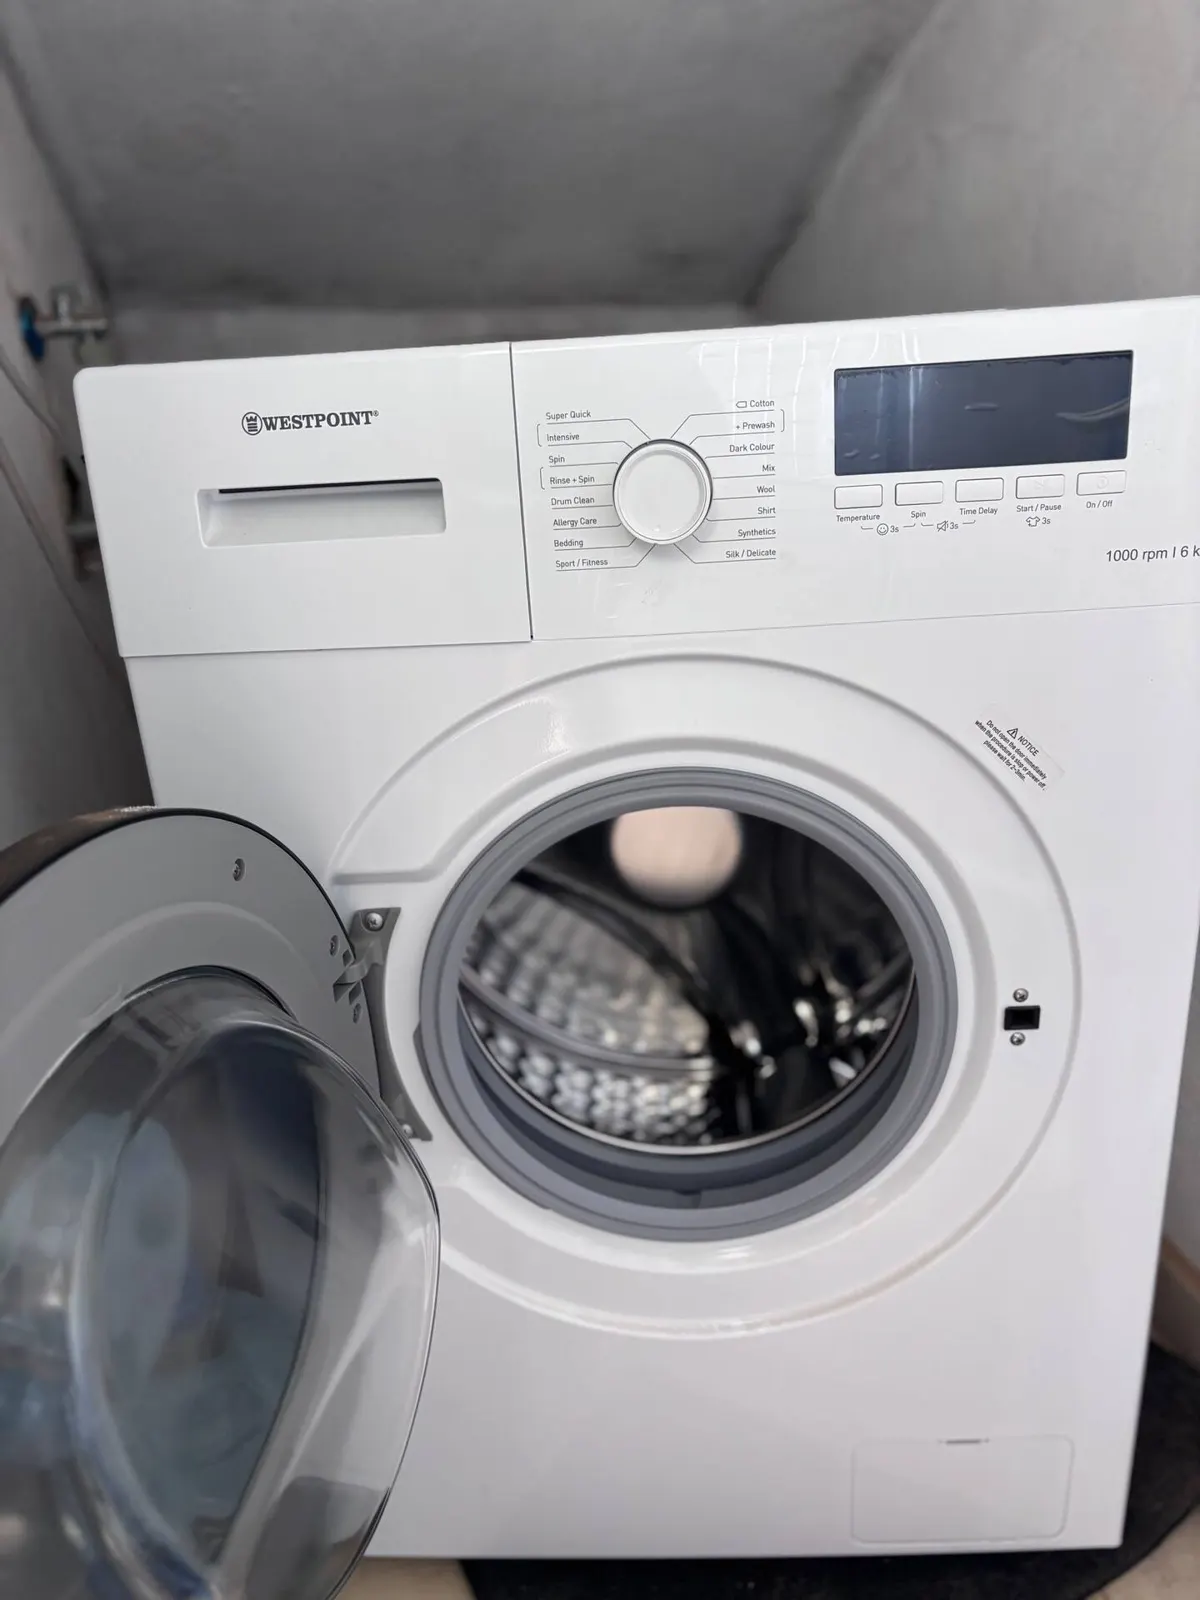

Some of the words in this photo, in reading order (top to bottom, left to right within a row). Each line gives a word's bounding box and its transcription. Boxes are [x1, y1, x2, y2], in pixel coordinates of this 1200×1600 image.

[749, 399, 775, 408] Cotton
[545, 412, 568, 420] Super
[570, 410, 591, 419] Quick
[742, 421, 775, 430] Prewash
[546, 433, 580, 441] Intensive
[729, 444, 747, 452] Dark
[748, 443, 775, 451] Colour
[548, 455, 565, 464] Spin
[762, 464, 776, 472] Mix
[549, 476, 570, 484] Rinse
[578, 475, 595, 483] Spin
[756, 485, 776, 494] Wool
[551, 498, 572, 506] Drum
[574, 496, 595, 504] Clean
[1102, 500, 1113, 508] Off
[757, 507, 776, 515] Shirt
[978, 506, 998, 516] Delay
[1016, 504, 1033, 512] Start
[1040, 503, 1062, 511] Pause
[836, 513, 881, 523] Temperature
[910, 510, 927, 519] Spin
[553, 518, 578, 527] Allergy
[580, 517, 597, 525] Care
[1041, 517, 1051, 525] 3s
[890, 525, 899, 533] 3s
[949, 522, 959, 530] 3s
[737, 527, 776, 537] Synthetics
[553, 539, 583, 548] Bedding
[725, 550, 740, 558] Silk
[746, 548, 776, 557] Delicate
[1106, 548, 1138, 562] 1000
[1142, 549, 1168, 562] rpm
[1180, 545, 1189, 557] 6
[555, 560, 576, 568] Sport
[582, 558, 608, 566] Fitness
[986, 719, 994, 728] Do
[992, 726, 1001, 735] not
[998, 732, 1010, 744] open
[1008, 741, 1017, 750] the
[1015, 748, 1025, 758] door
[1024, 756, 1048, 780] immediately
[1018, 735, 1039, 756] NOTICE
[975, 720, 987, 732] when
[985, 729, 994, 738] the
[991, 736, 1012, 756] procedure
[1026, 770, 1040, 783] power
[983, 740, 999, 754] please
[997, 752, 1007, 762] wait
[1004, 759, 1012, 767] for
